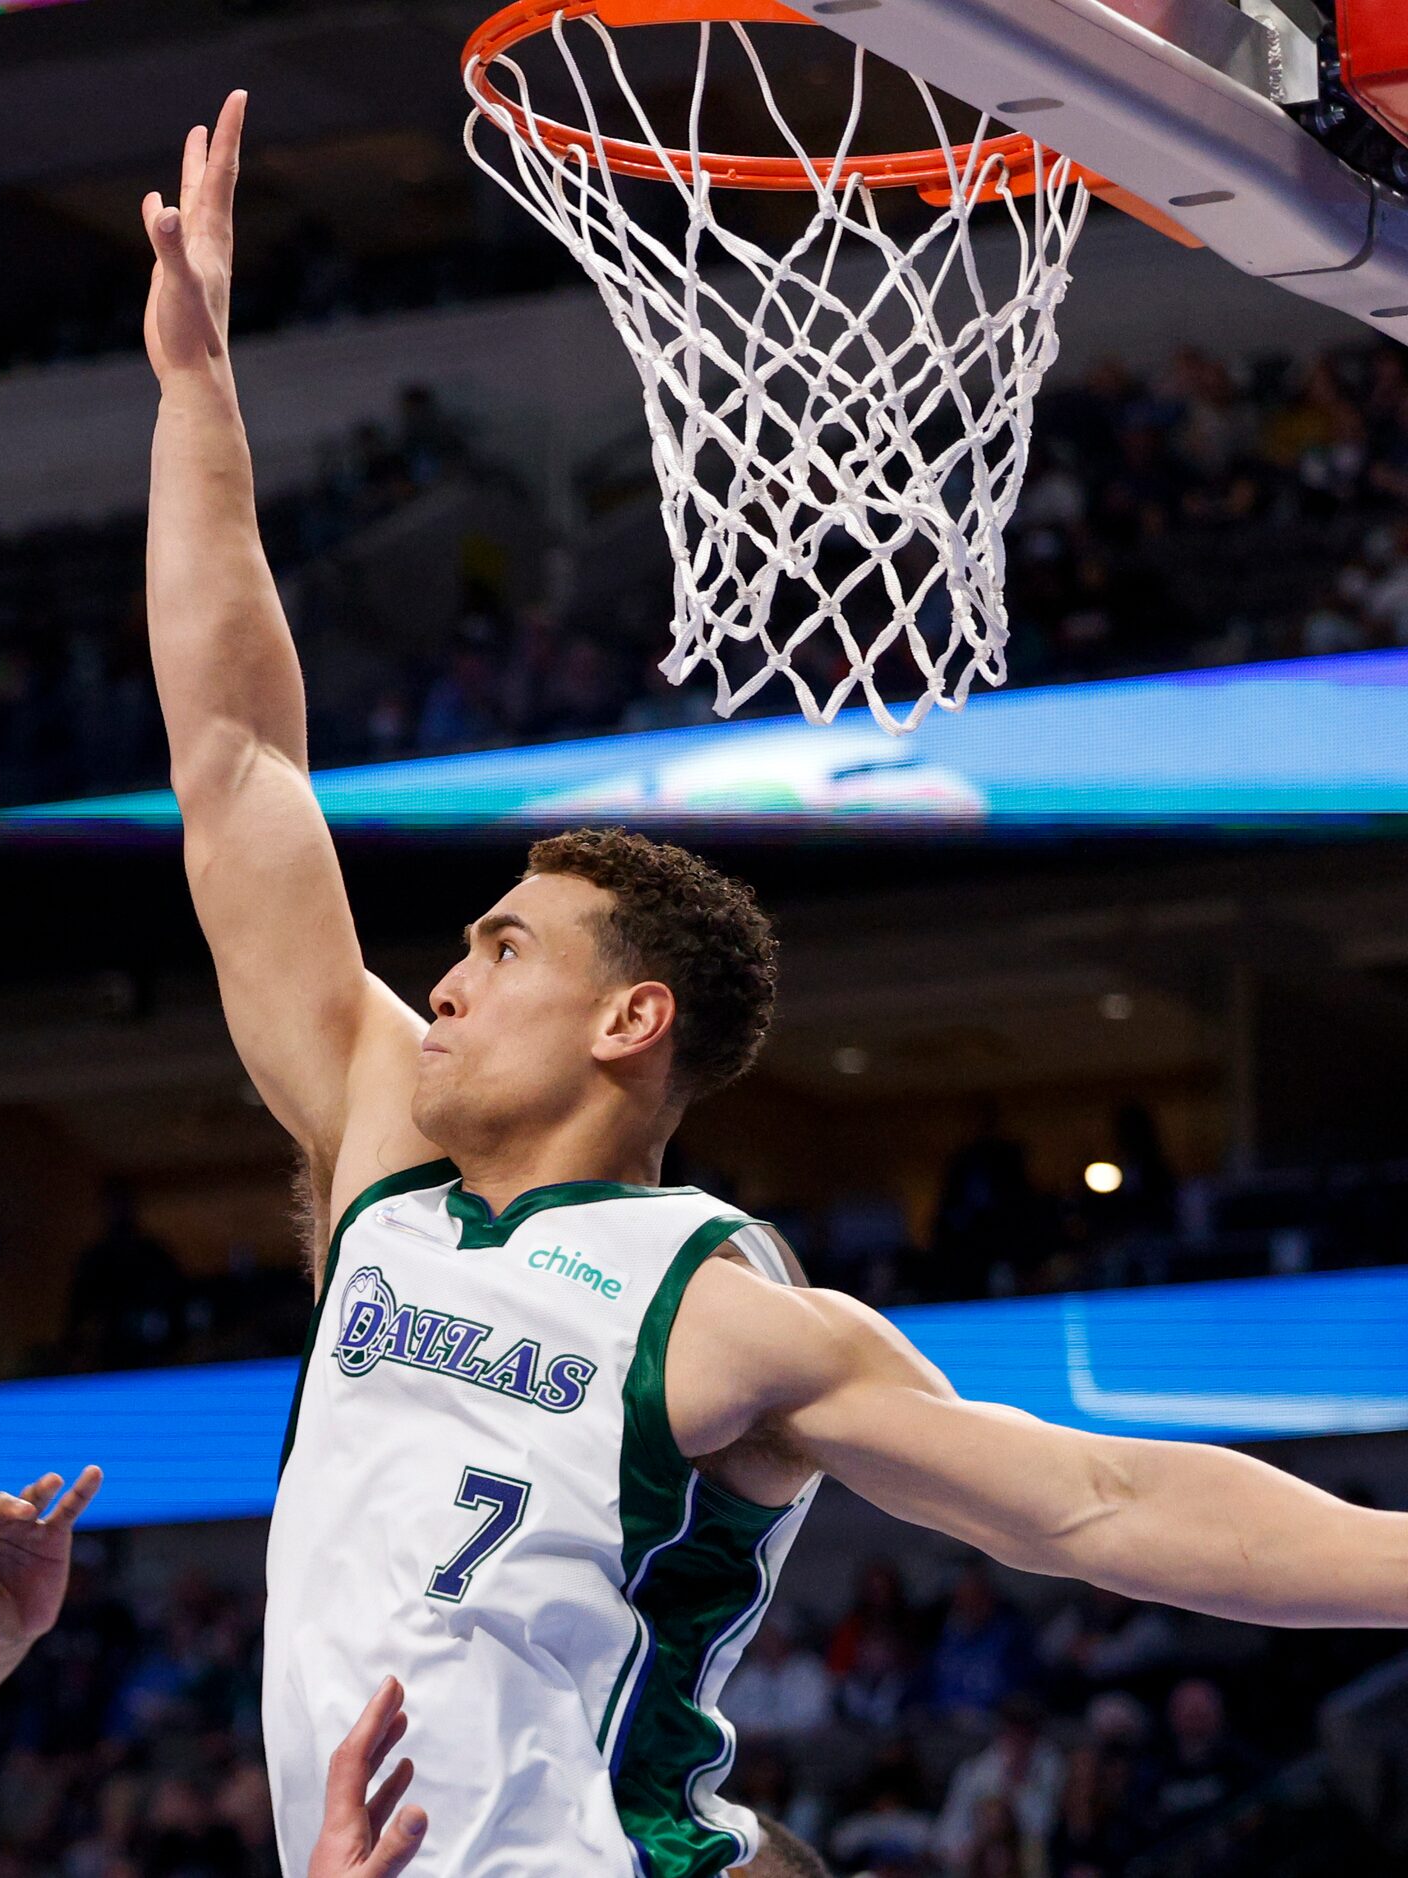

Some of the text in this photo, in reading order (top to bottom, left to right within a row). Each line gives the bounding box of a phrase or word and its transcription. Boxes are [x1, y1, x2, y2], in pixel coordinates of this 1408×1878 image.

[528, 1245, 622, 1299] chime
[332, 1298, 597, 1413] DALLAS
[426, 1466, 531, 1603] 7
